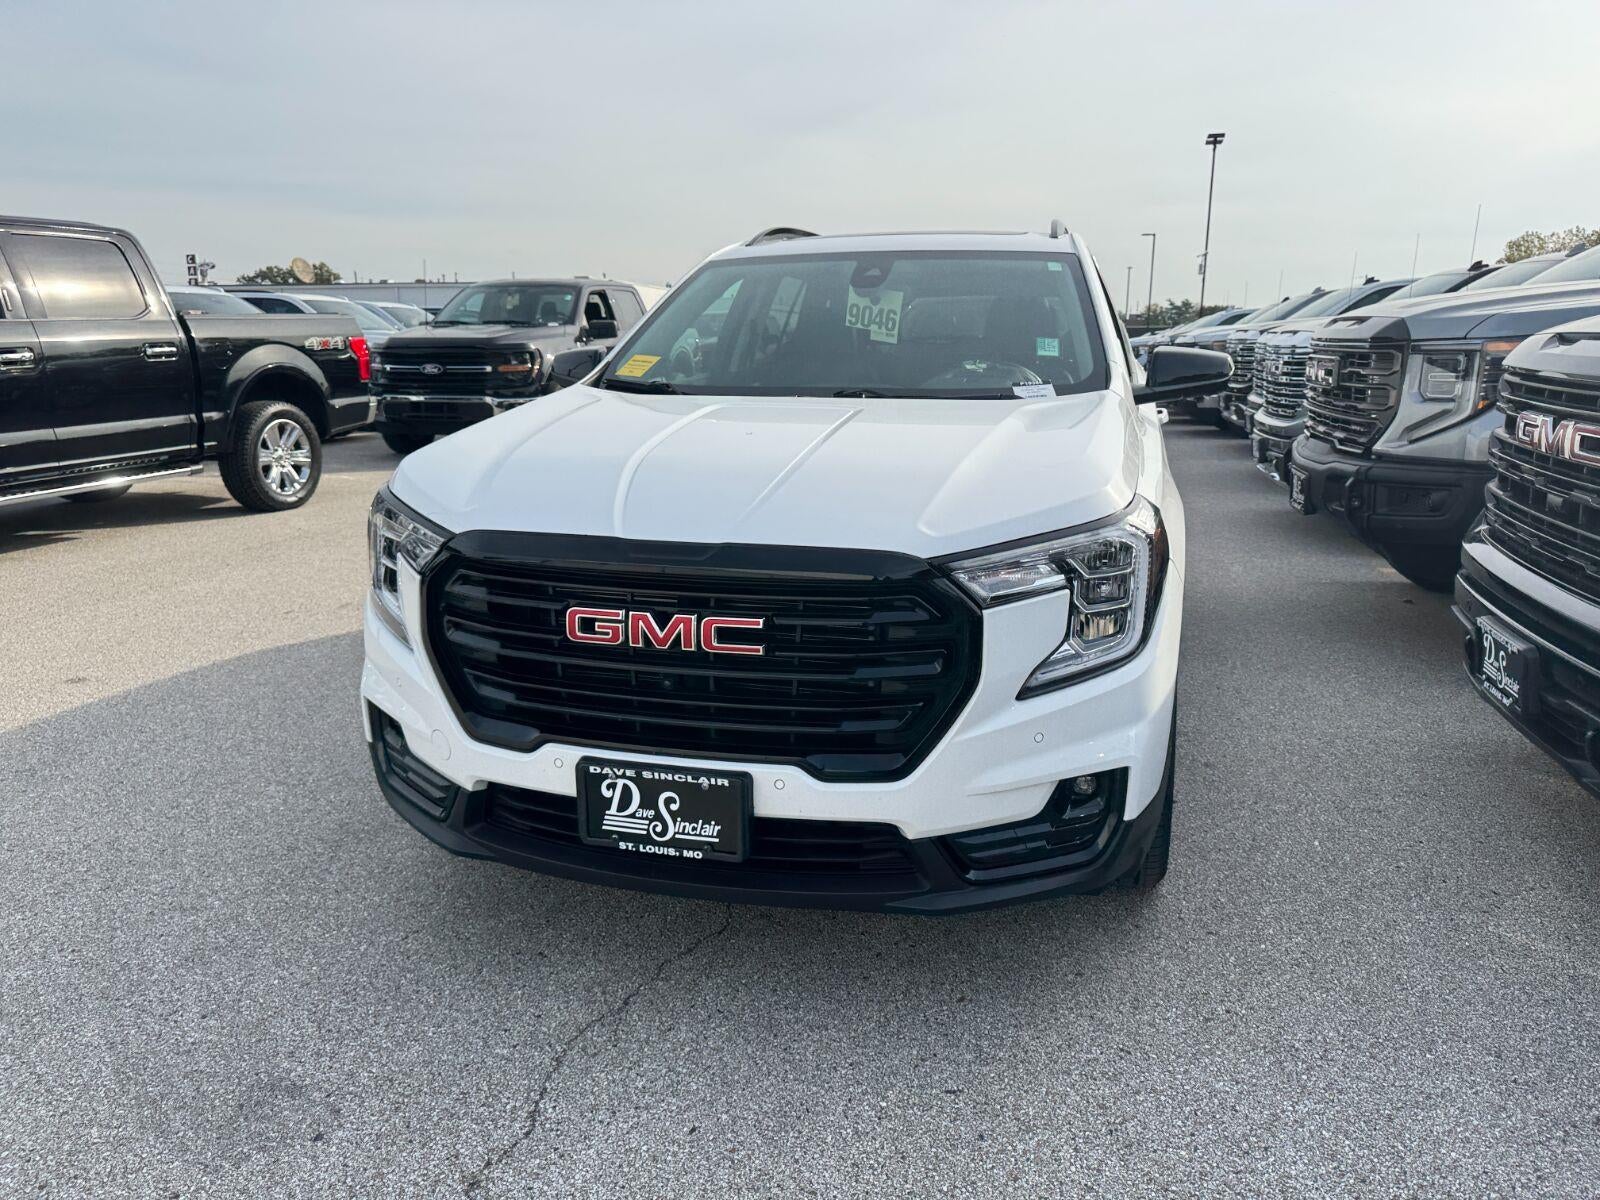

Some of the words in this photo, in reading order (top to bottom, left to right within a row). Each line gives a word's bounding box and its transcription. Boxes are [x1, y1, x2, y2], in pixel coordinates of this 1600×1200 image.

[848, 303, 898, 332] 9046
[1516, 411, 1600, 467] GMC
[566, 607, 766, 655] GMC
[588, 765, 637, 777] DAVE
[641, 771, 730, 787] SINCLAIR
[601, 778, 655, 819] Dave
[649, 791, 721, 842] Sinclair
[618, 841, 636, 851] ST.
[640, 845, 680, 857] LOUIS,
[683, 850, 703, 859] MO
